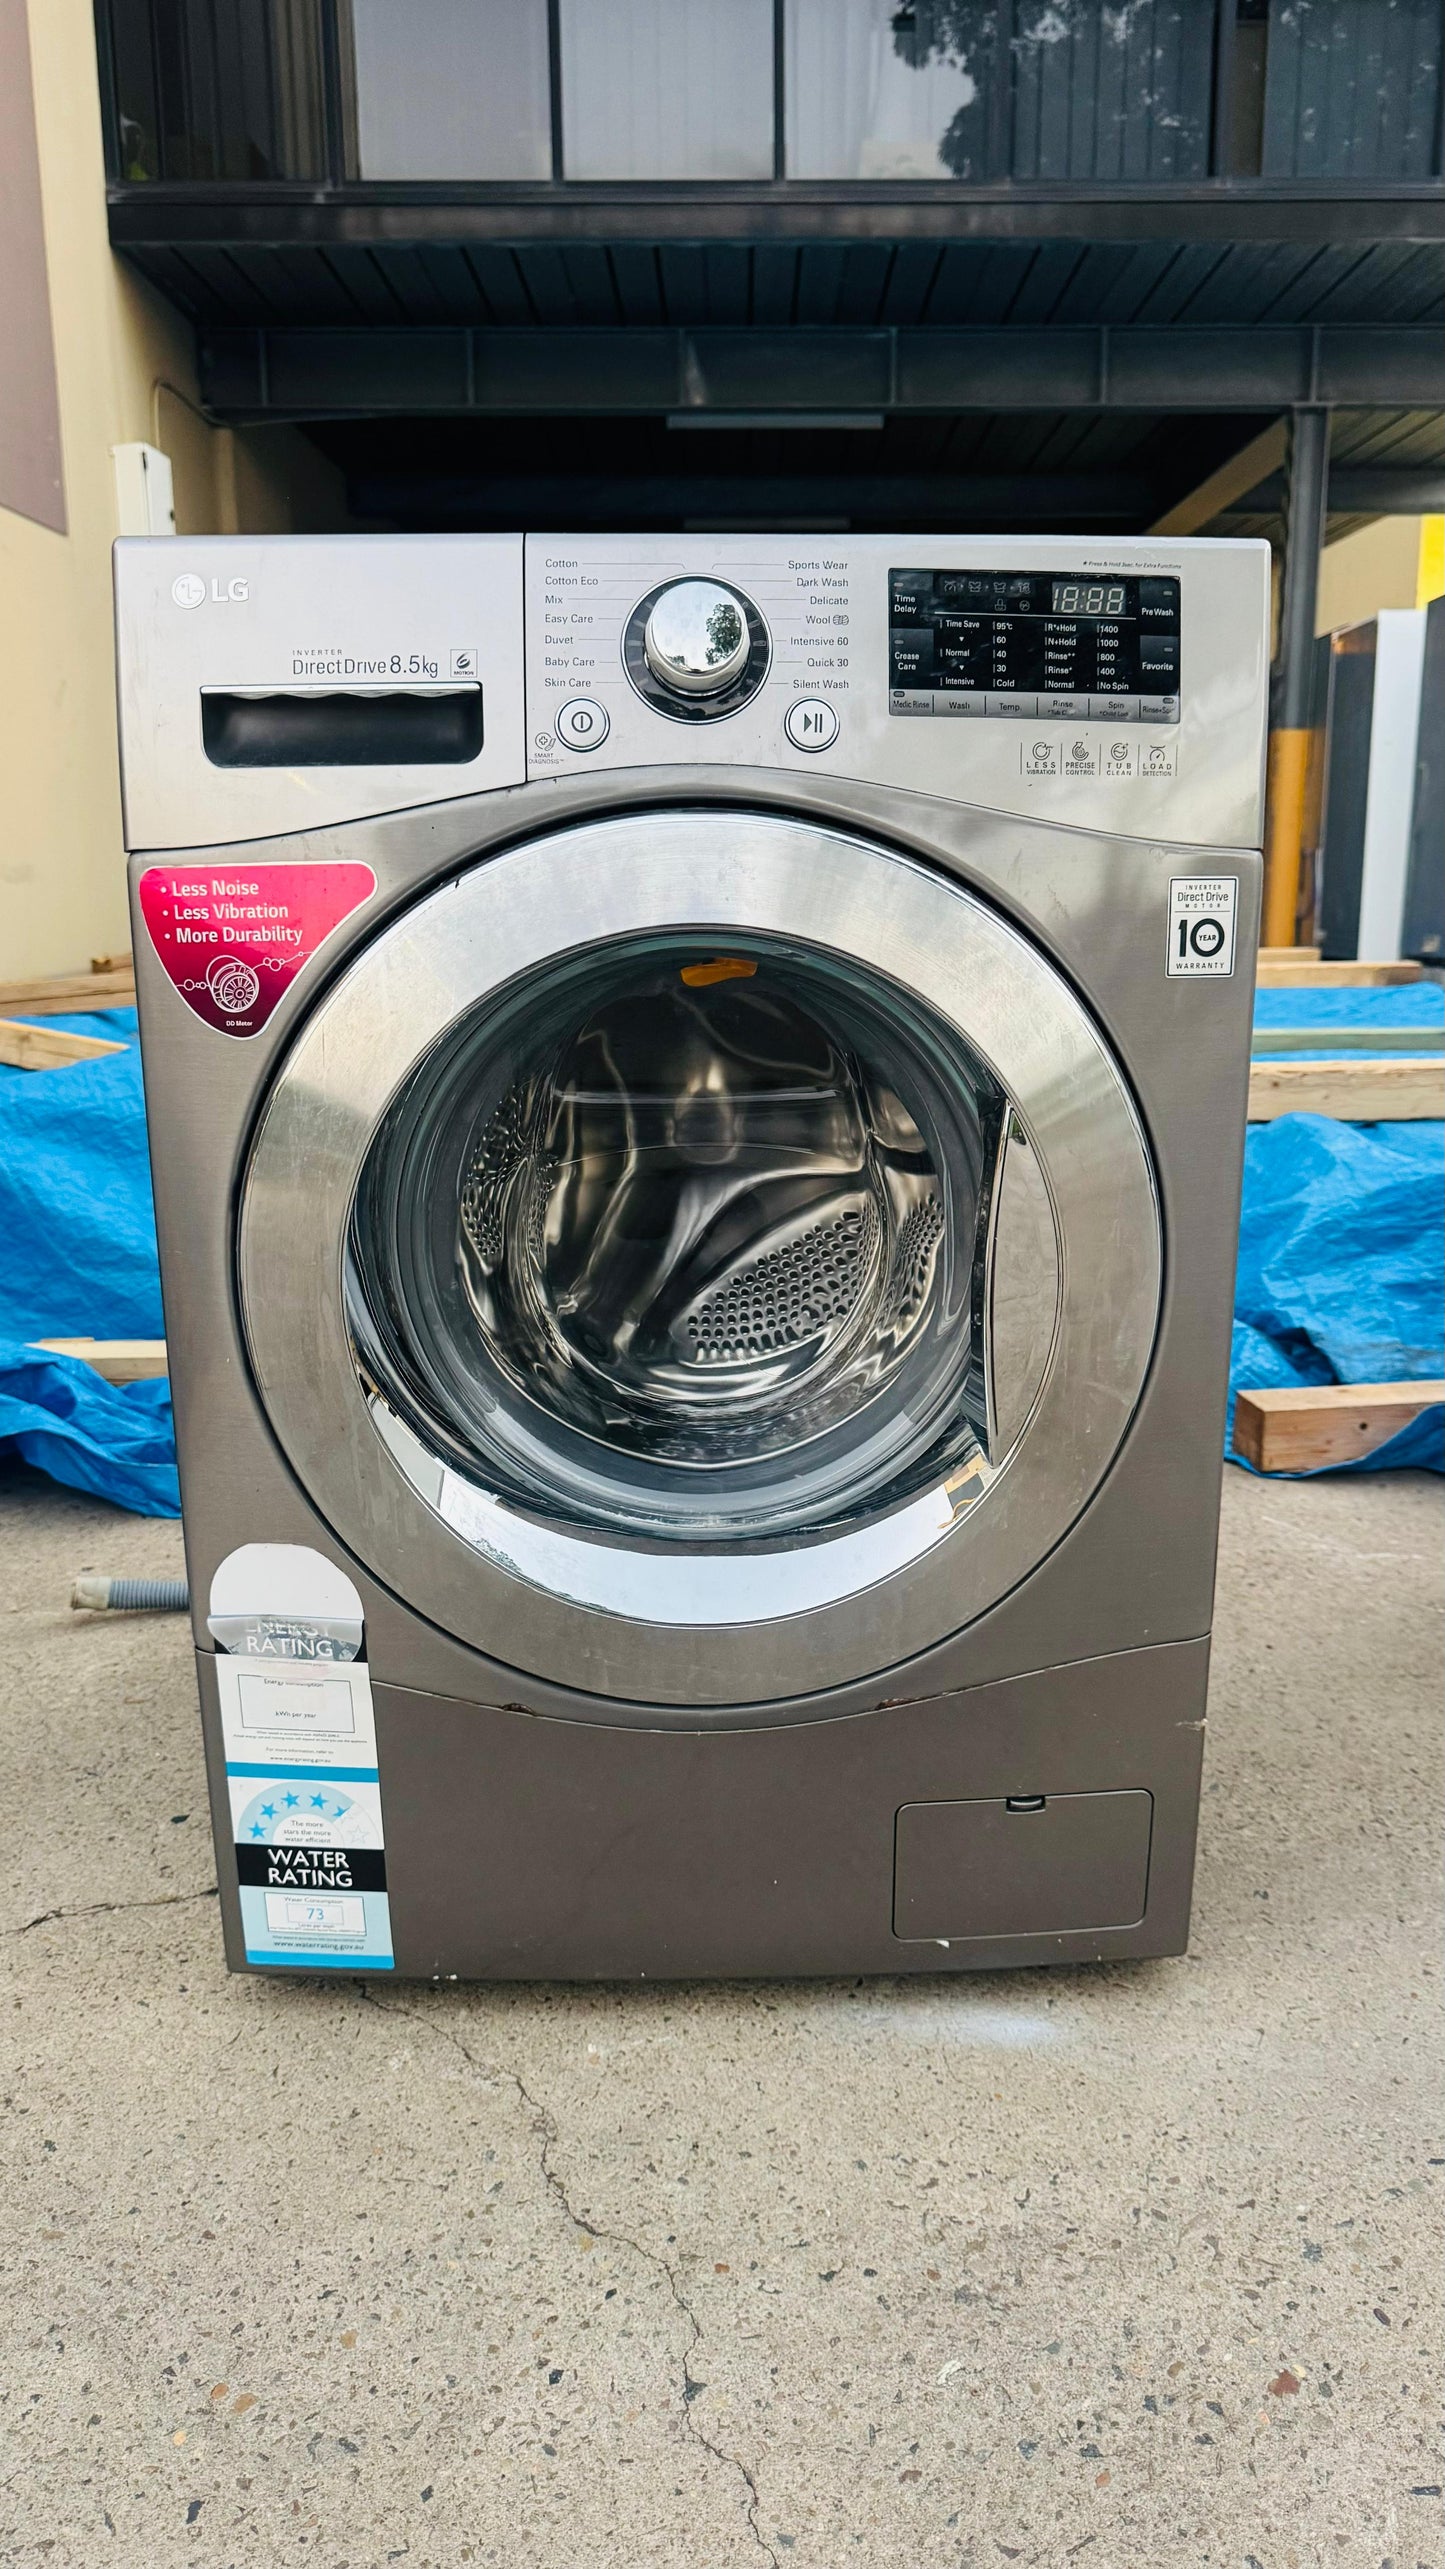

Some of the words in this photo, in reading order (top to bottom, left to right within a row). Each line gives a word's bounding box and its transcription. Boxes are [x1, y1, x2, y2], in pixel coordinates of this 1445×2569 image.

[545, 559, 578, 568] Cotton
[788, 560, 820, 571] Sports
[822, 561, 848, 570] Wear
[545, 576, 578, 585] Cotton
[581, 576, 598, 586] Eco
[796, 577, 819, 587] Dark
[821, 578, 849, 587] Wash
[212, 578, 249, 602] LG
[545, 595, 563, 604] Mix
[810, 596, 849, 605] Delicate
[895, 595, 916, 603] Time
[894, 605, 917, 614] Delay
[1153, 608, 1174, 616] Wash
[545, 614, 568, 624] Easy
[571, 614, 594, 623] Care
[806, 615, 831, 624] Wool
[945, 620, 962, 628] Time
[545, 635, 574, 644] Duvet
[790, 637, 834, 646] Intensive
[837, 637, 849, 646] 60
[996, 636, 1006, 644] 60
[1048, 638, 1076, 646] N+Hold
[894, 652, 919, 660] Crease
[945, 648, 970, 656] Normal
[996, 650, 1006, 658] 40
[1100, 653, 1115, 661] 800
[545, 657, 570, 668] Baby
[572, 657, 595, 666] Care
[807, 658, 834, 667] Quick
[837, 658, 849, 667] 30
[1142, 662, 1174, 671] Favorite
[996, 664, 1006, 672] 30
[544, 677, 566, 687] Skin
[568, 678, 591, 687] Care
[793, 679, 820, 689] Silent
[822, 680, 849, 689] Wash
[945, 677, 975, 685] Intensive
[996, 679, 1015, 687] Cold
[1100, 682, 1112, 690] No
[1112, 683, 1129, 691] Spin
[893, 700, 912, 708] Medic
[912, 701, 930, 709] Rinse
[949, 702, 970, 710] Wash
[1053, 700, 1073, 708] Rinse
[1108, 701, 1124, 709] Spin
[1026, 761, 1056, 769] LESS
[1107, 762, 1132, 770] TUB
[172, 881, 208, 897] Less
[212, 880, 259, 896] Noise
[1178, 892, 1204, 901] Direct
[1206, 892, 1229, 901] Drive
[174, 905, 210, 920] Less
[213, 903, 288, 919] Vibration
[176, 927, 218, 944] More
[223, 926, 303, 946] Durability
[1178, 918, 1225, 957] 10
[246, 1636, 333, 1657] RATING
[267, 1848, 349, 1869] WATER
[268, 1867, 353, 1887] RATING
[306, 1908, 324, 1920] 73
